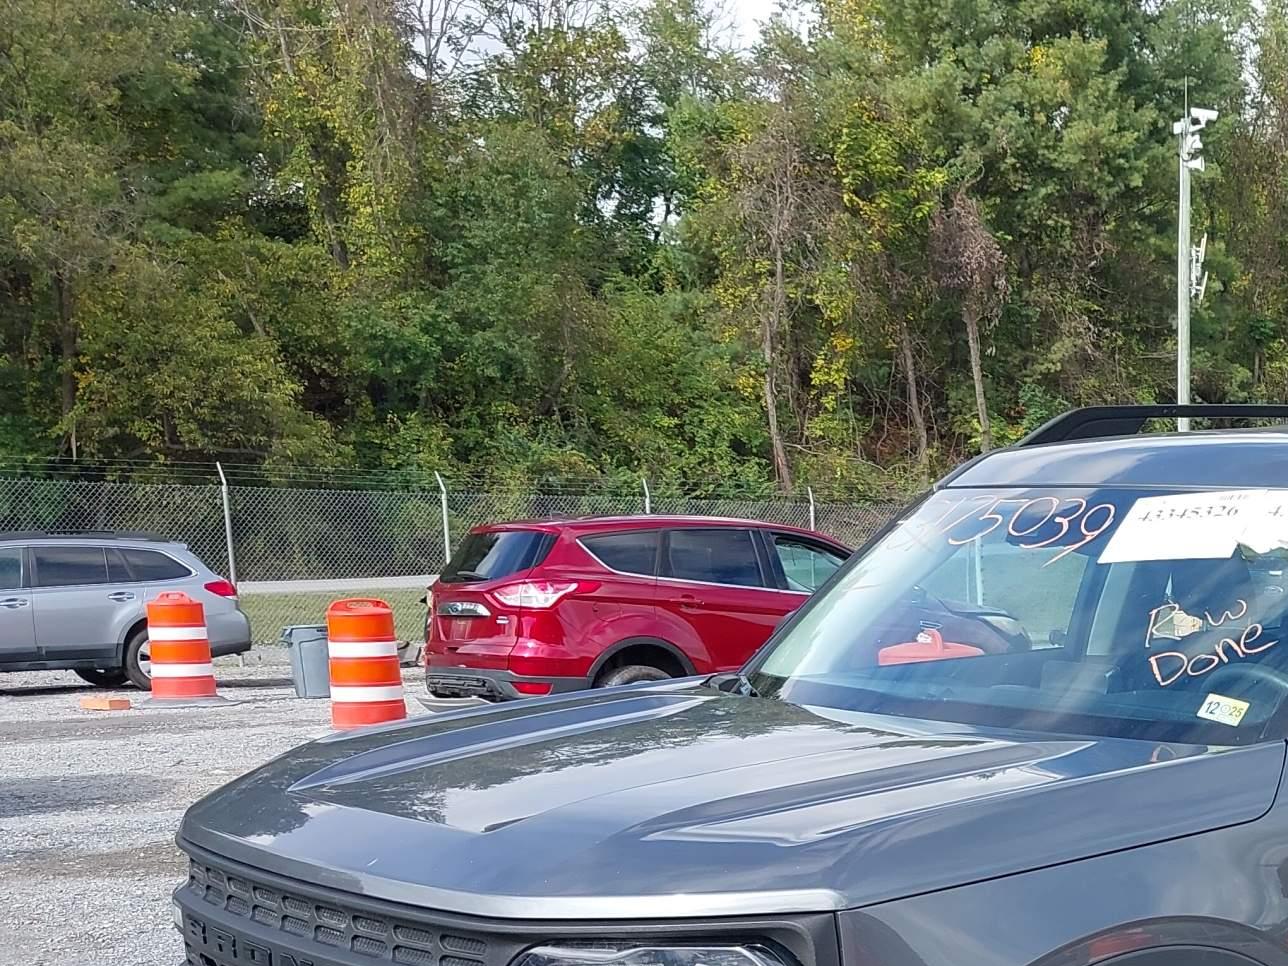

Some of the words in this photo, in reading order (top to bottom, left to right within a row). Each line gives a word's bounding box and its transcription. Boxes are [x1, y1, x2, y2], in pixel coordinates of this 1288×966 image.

[1148, 623, 1280, 687] Done
[1205, 701, 1221, 715] 12
[1229, 706, 1244, 718] 25
